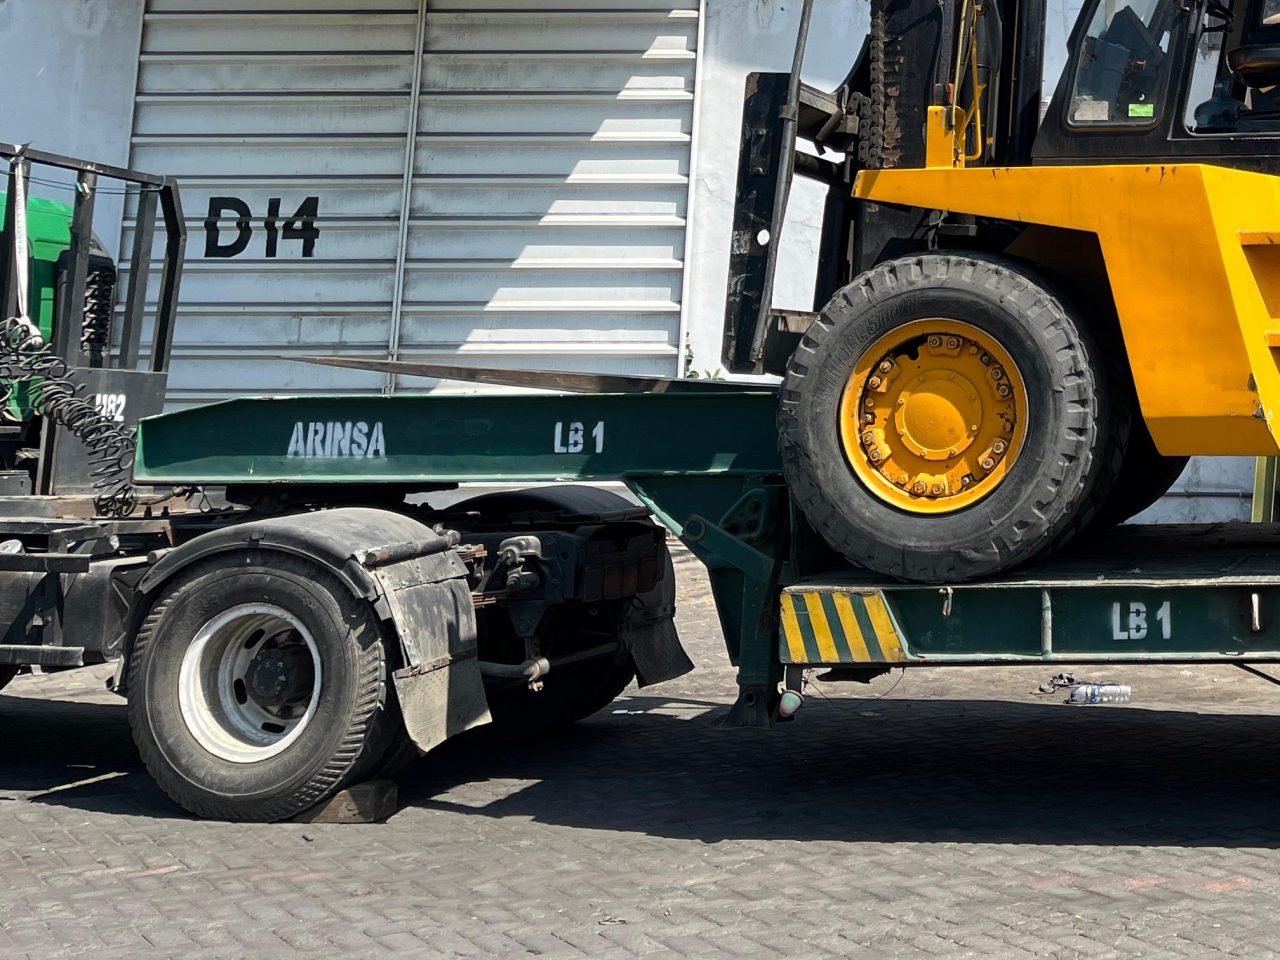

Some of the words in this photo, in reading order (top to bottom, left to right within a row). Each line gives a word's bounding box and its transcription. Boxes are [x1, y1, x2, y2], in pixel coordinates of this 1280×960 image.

[286, 421, 386, 459] ARINSA
[554, 421, 584, 454] LB
[592, 421, 605, 454] 1
[1111, 601, 1148, 641] LB
[1156, 600, 1171, 640] 1
